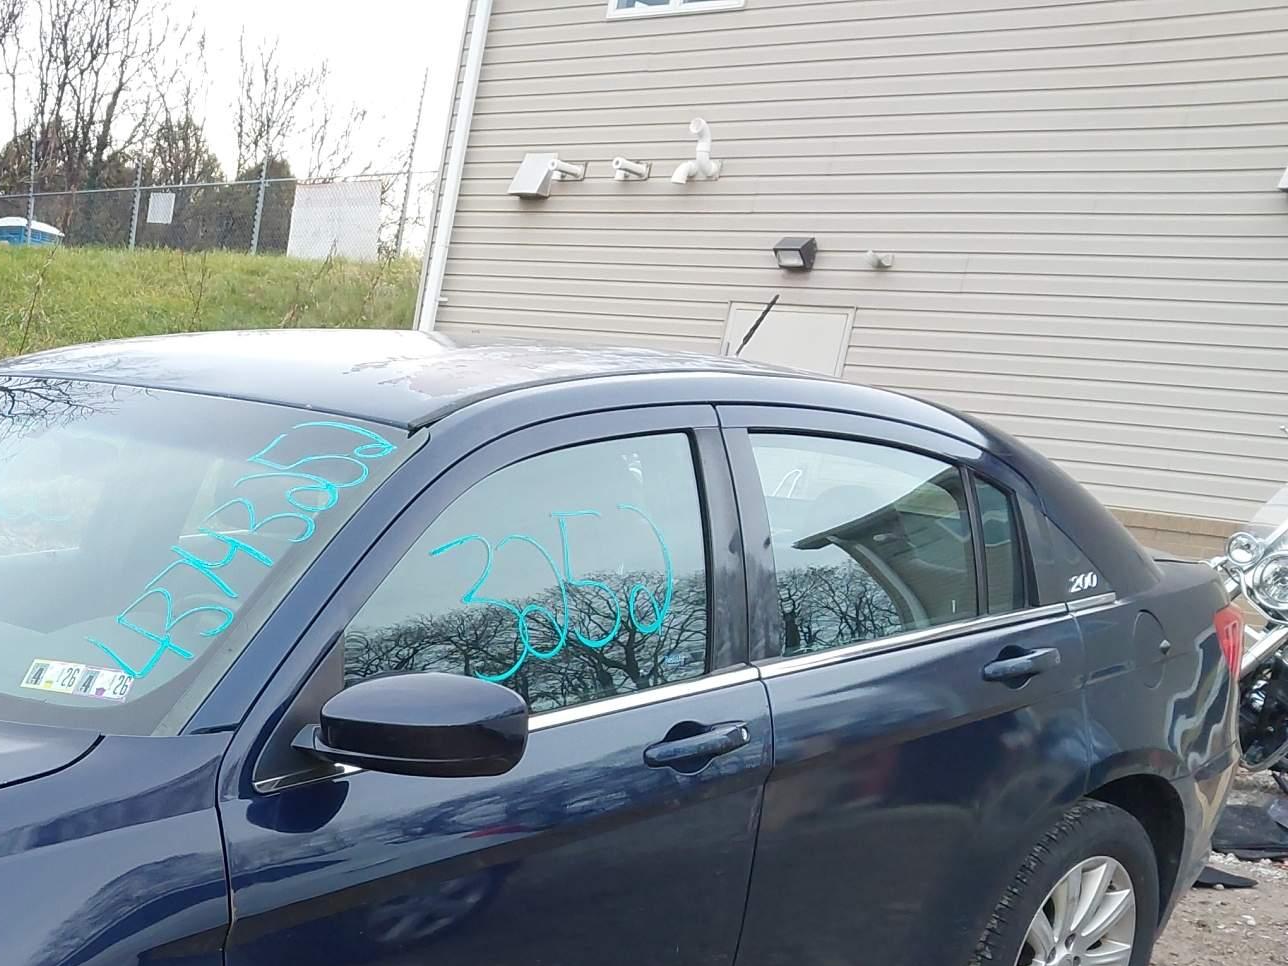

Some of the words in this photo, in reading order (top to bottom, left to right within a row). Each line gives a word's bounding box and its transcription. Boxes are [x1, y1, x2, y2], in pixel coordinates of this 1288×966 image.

[1068, 571, 1098, 593] 200
[61, 667, 80, 688] 26
[112, 675, 133, 697] 26
